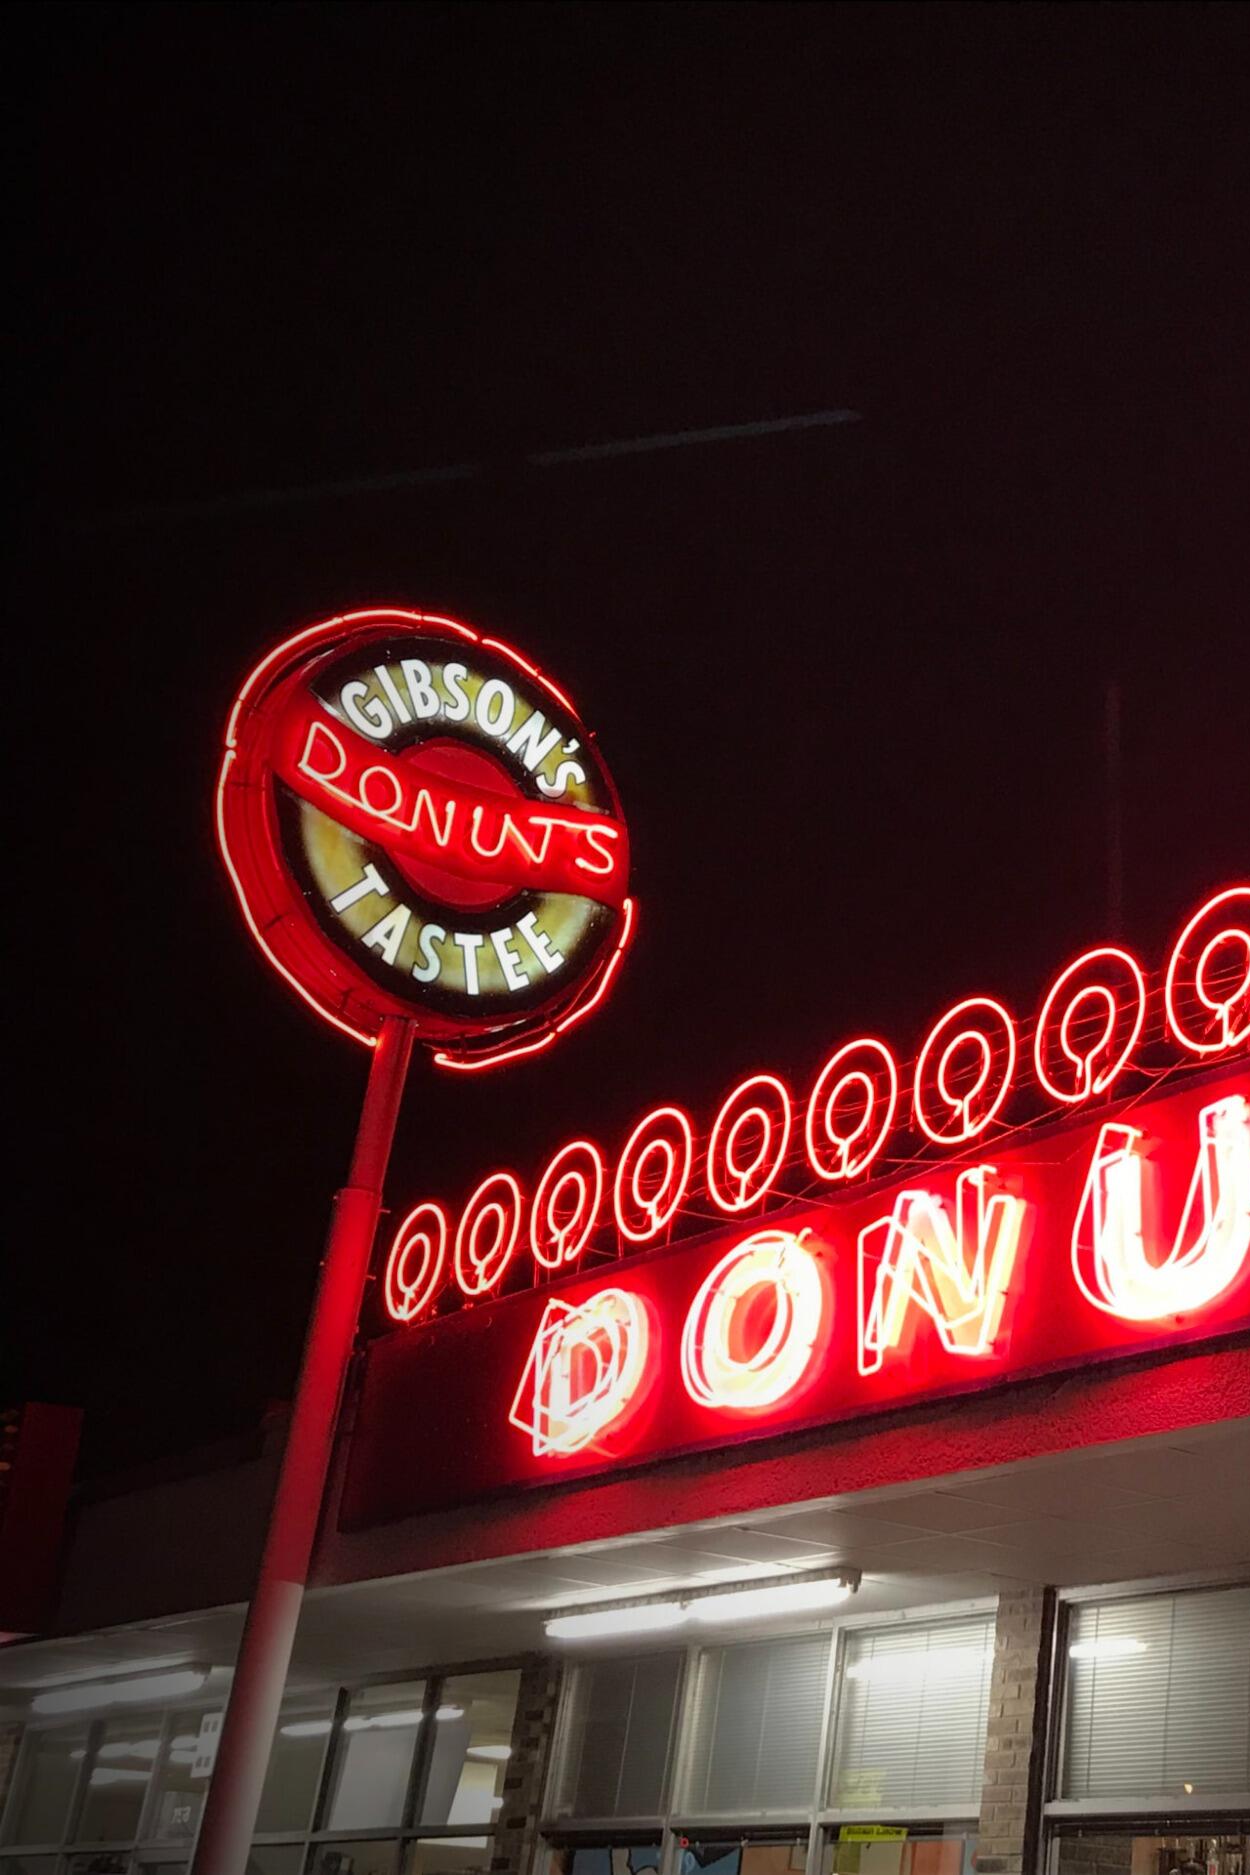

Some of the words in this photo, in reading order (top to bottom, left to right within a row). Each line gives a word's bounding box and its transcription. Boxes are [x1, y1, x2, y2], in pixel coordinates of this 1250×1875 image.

[340, 658, 586, 797] GIBSON'S
[297, 721, 619, 874] DONUTS
[330, 863, 565, 995] TASTEE
